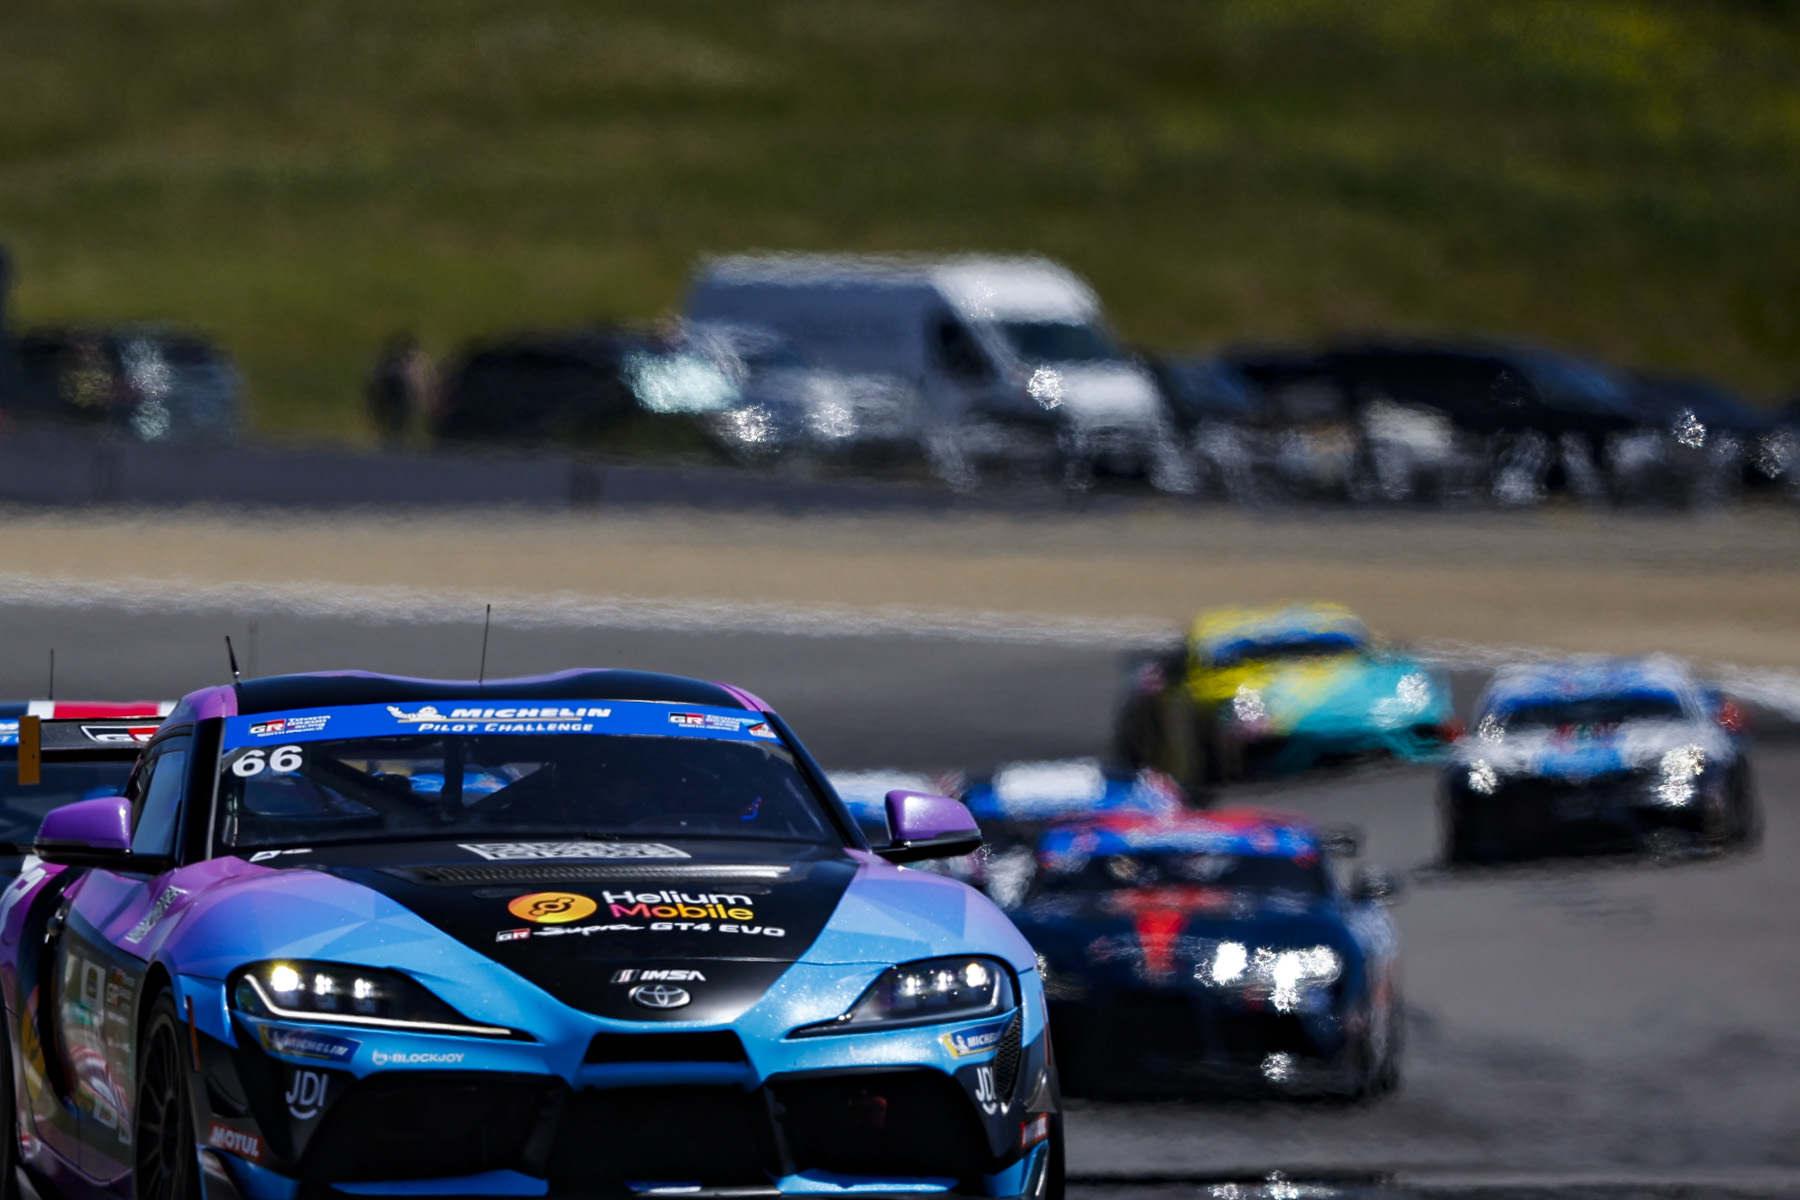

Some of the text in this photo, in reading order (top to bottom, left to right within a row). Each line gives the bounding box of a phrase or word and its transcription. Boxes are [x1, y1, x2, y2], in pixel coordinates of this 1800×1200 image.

[450, 708, 612, 718] MICHELIN
[670, 715, 703, 725] GR
[249, 722, 284, 734] GR
[418, 723, 594, 732] PILOT CHALLENGE
[232, 745, 303, 777] 66
[602, 890, 753, 905] Helium
[610, 903, 754, 920] Mobile
[498, 922, 786, 942] GR Supra GT4 EVO
[640, 970, 707, 981] IMSA
[283, 1037, 349, 1056] MICHELIN
[966, 1032, 1000, 1048] MICHEL
[392, 1053, 465, 1063] BLOCKJOY
[285, 1070, 329, 1107] JDI
[211, 1125, 260, 1158] MOTUL
